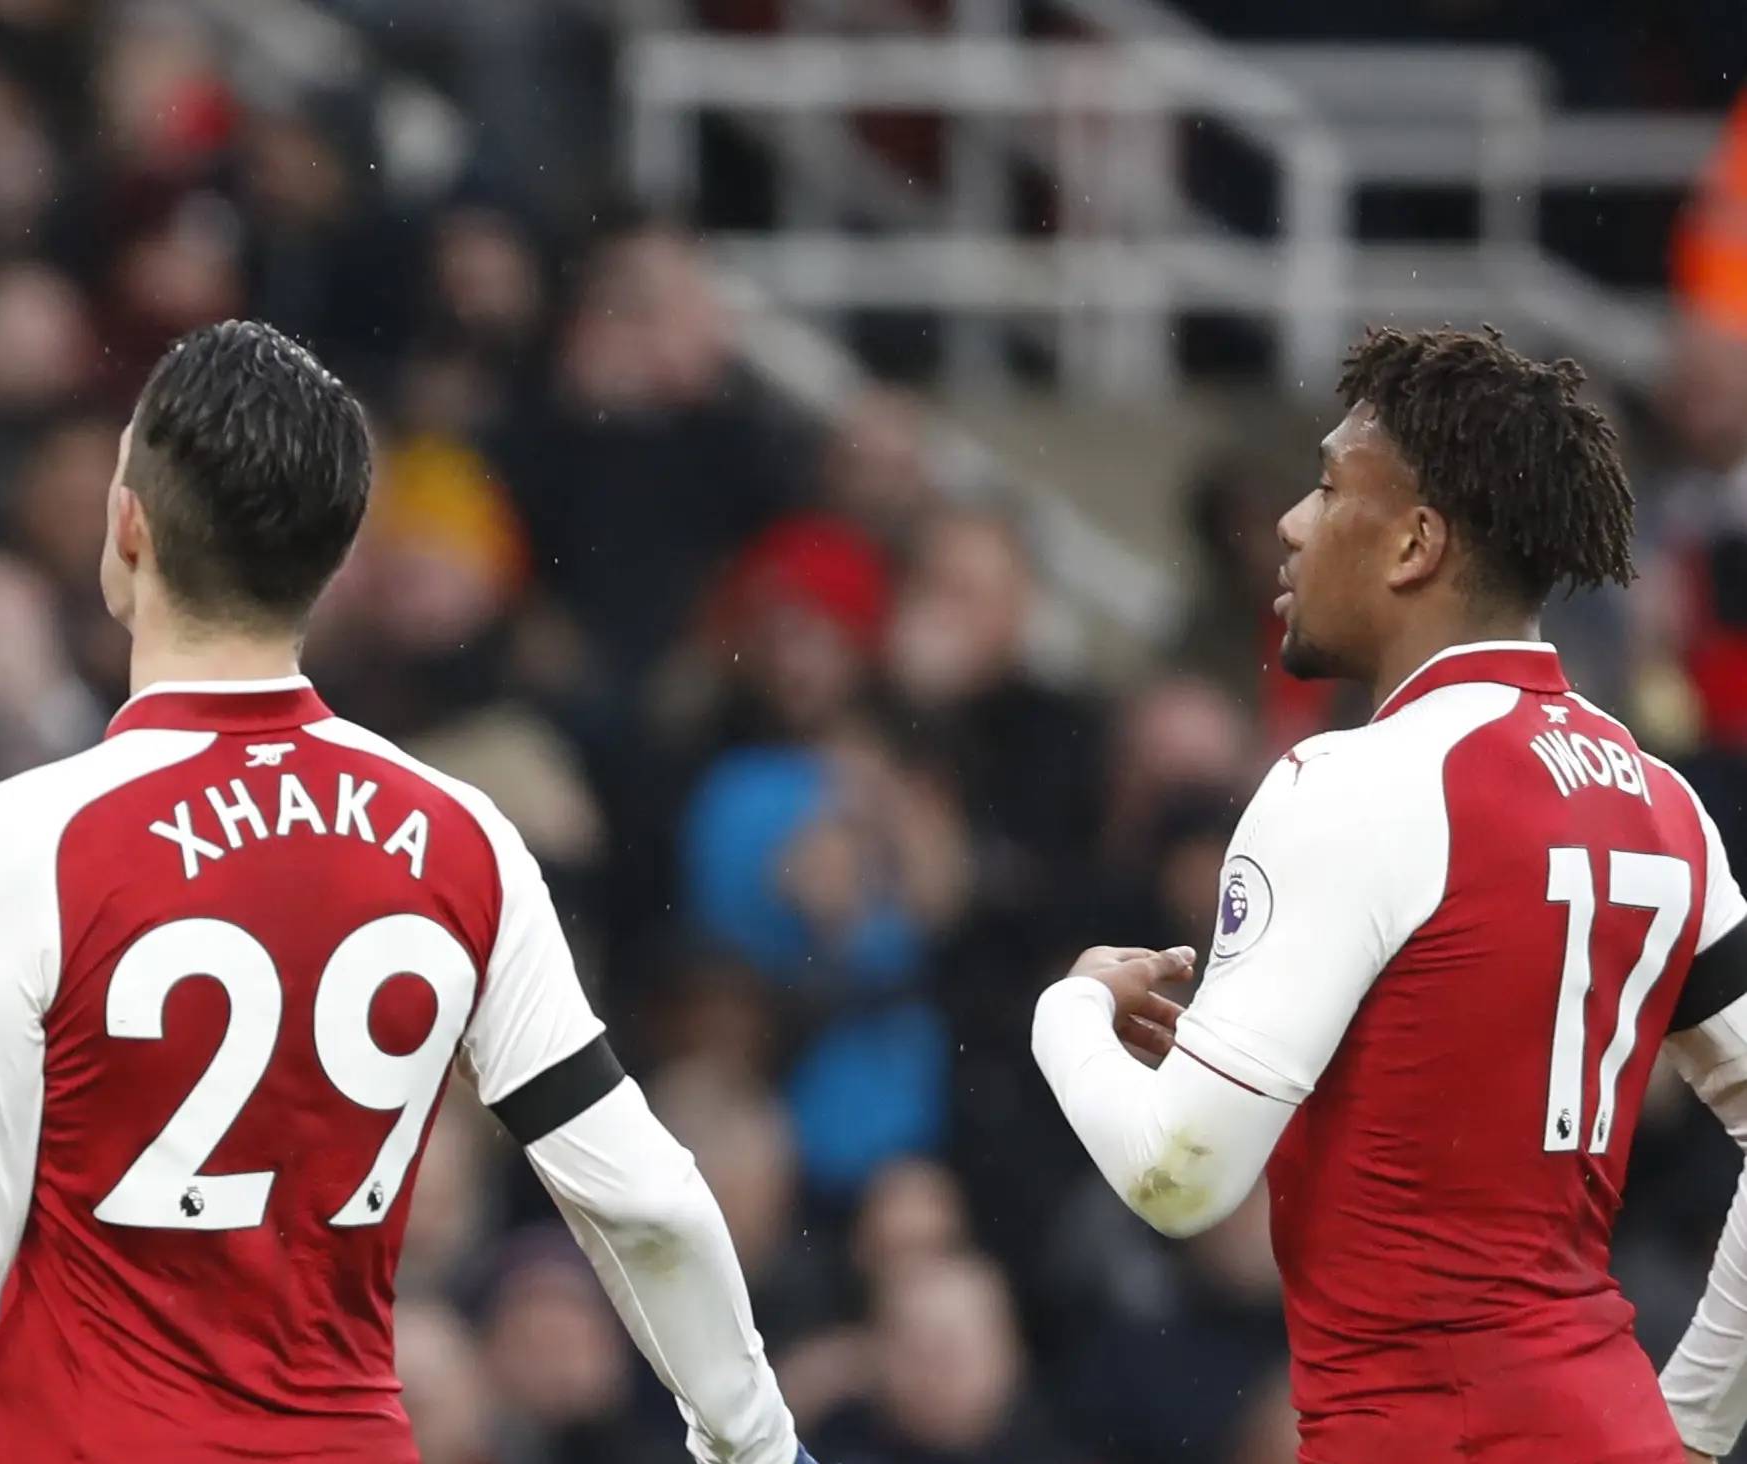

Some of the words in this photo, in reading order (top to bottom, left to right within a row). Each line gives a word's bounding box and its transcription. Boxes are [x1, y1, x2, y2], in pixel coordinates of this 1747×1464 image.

[149, 772, 430, 880] XHAKA
[1530, 730, 1652, 806] IWOBI
[93, 913, 478, 1231] 29
[1543, 847, 1692, 1154] 17
